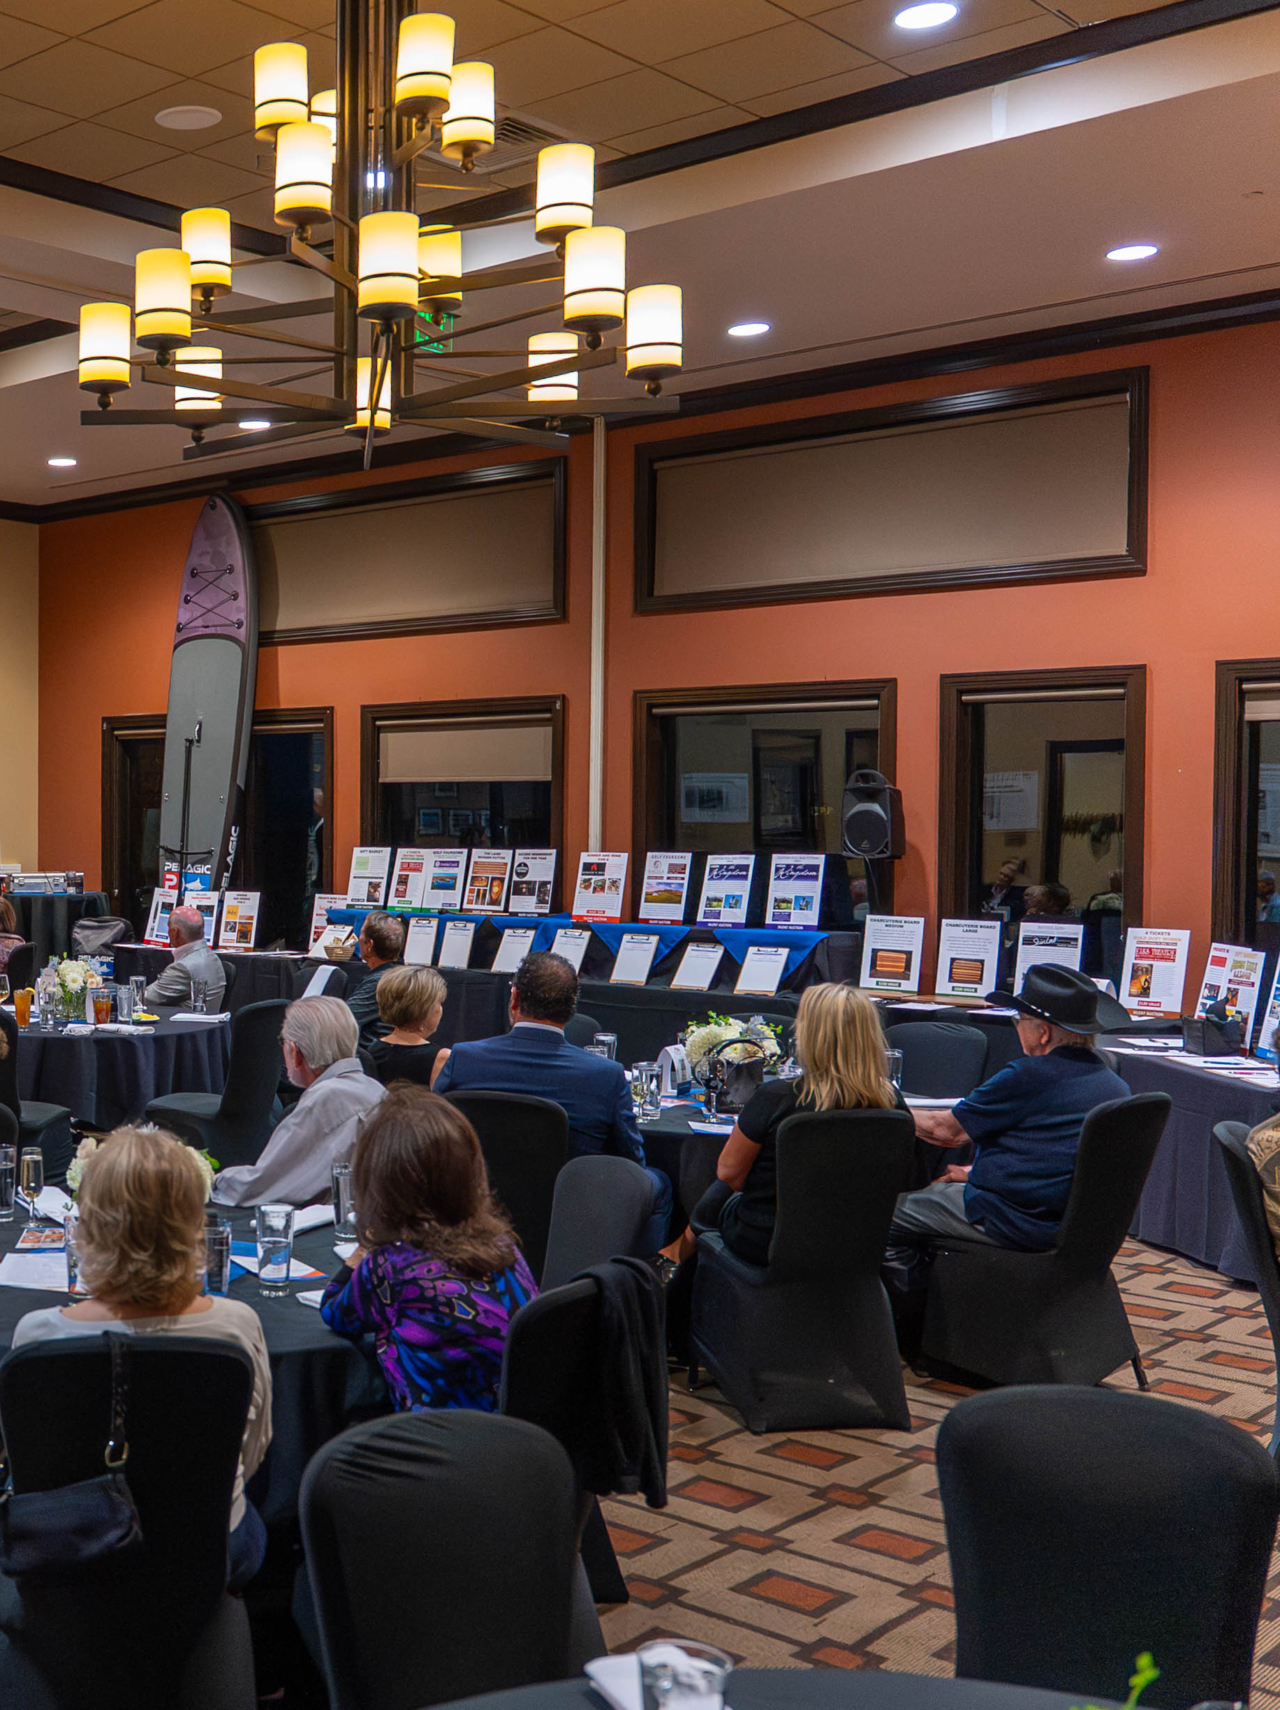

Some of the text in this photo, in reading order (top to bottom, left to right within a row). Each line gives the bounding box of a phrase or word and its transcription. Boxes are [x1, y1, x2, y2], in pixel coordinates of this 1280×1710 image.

[220, 826, 239, 901] PELAGIC
[708, 866, 747, 880] Kingdom
[774, 865, 817, 881] Kingdom
[78, 955, 114, 963] PELAGIC
